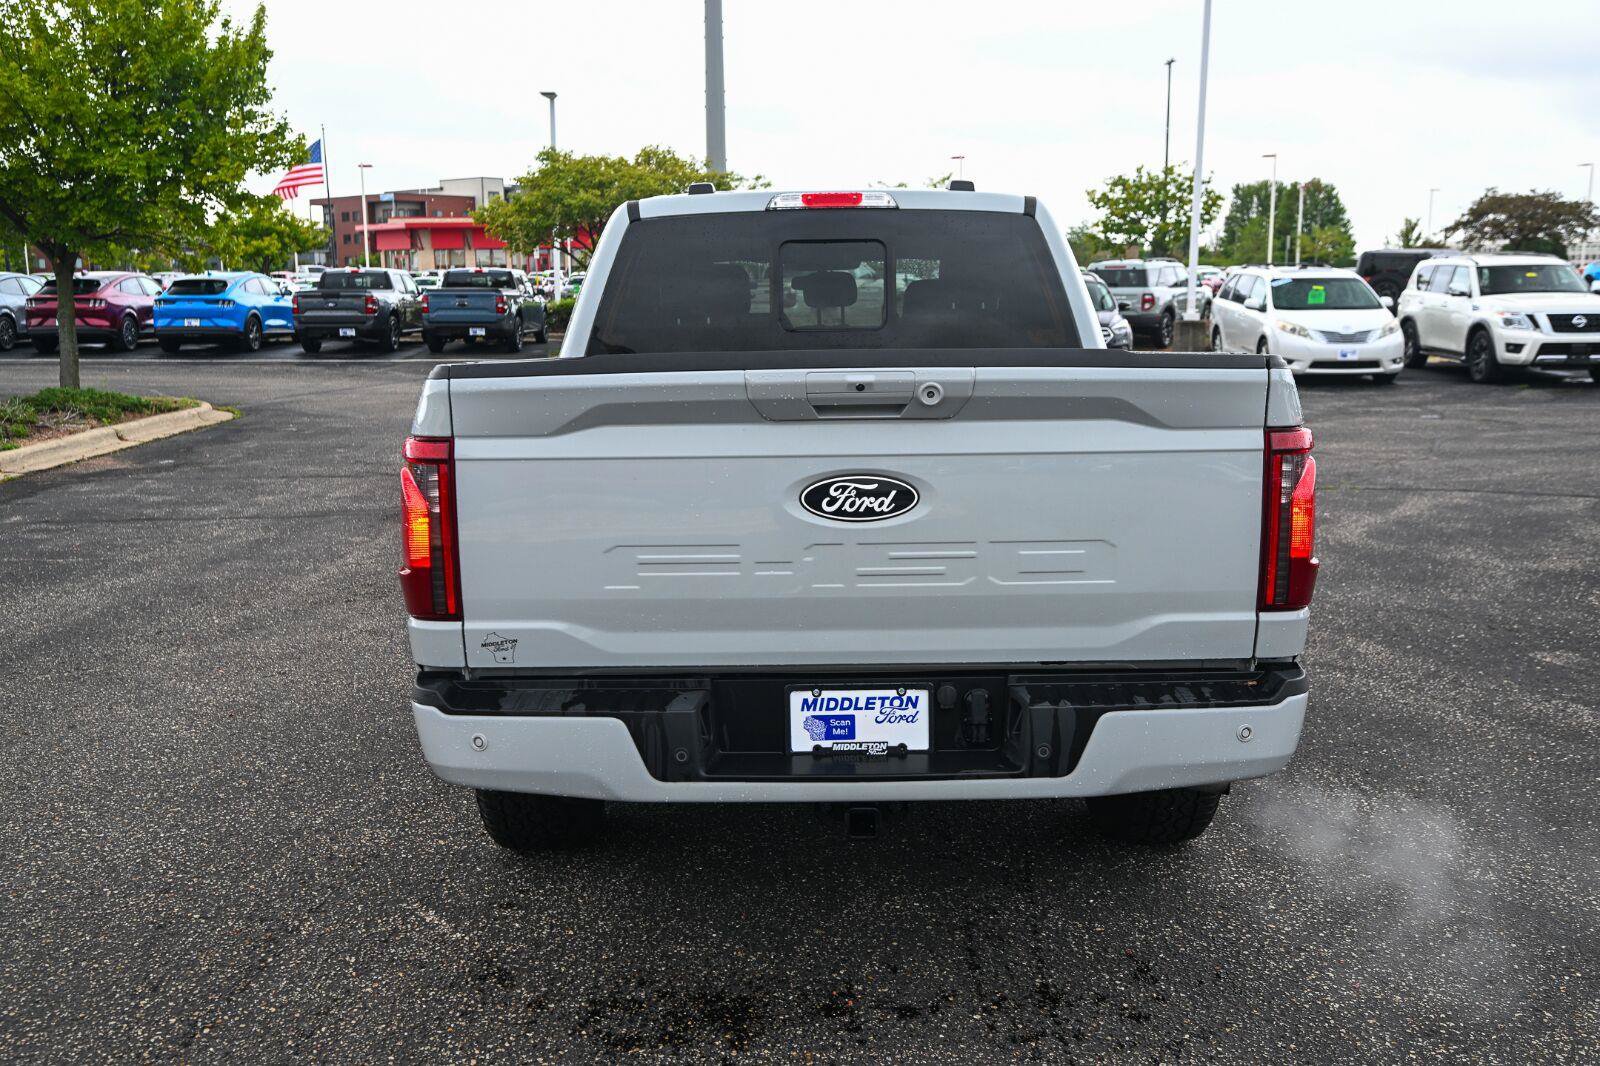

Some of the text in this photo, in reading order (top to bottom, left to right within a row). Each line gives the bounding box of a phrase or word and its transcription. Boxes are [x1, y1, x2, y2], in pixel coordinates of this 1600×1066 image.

[821, 482, 897, 512] Ford
[481, 638, 518, 648] MIDDLETON
[800, 695, 920, 712] MIDDLETON
[874, 706, 919, 724] Ford
[832, 742, 887, 751] MIDDLETON
